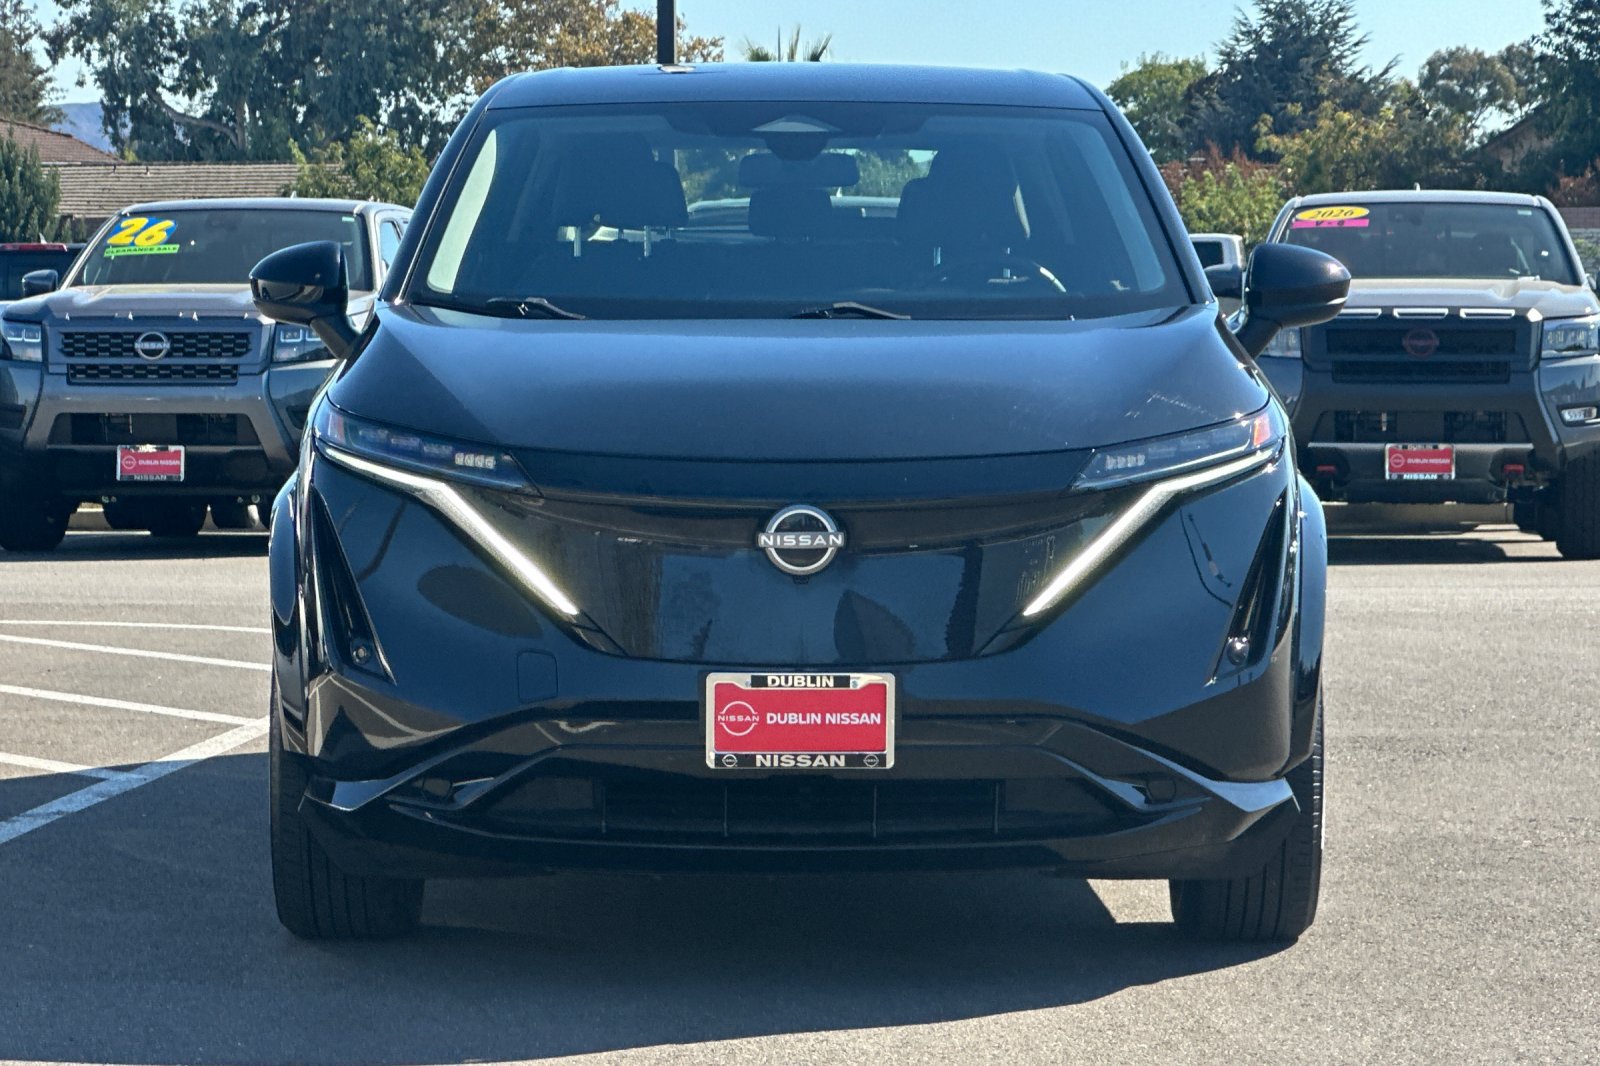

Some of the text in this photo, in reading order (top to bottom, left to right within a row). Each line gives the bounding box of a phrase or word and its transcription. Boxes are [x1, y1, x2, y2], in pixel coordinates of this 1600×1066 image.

[1308, 209, 1354, 219] 2026
[107, 217, 174, 246] 26
[105, 247, 155, 255] CLEARANCE
[760, 534, 842, 546] NISSAN
[767, 675, 834, 688] DUBLIN
[766, 712, 881, 725] DUBLIN NISSAN
[756, 754, 846, 767] NISSAN
